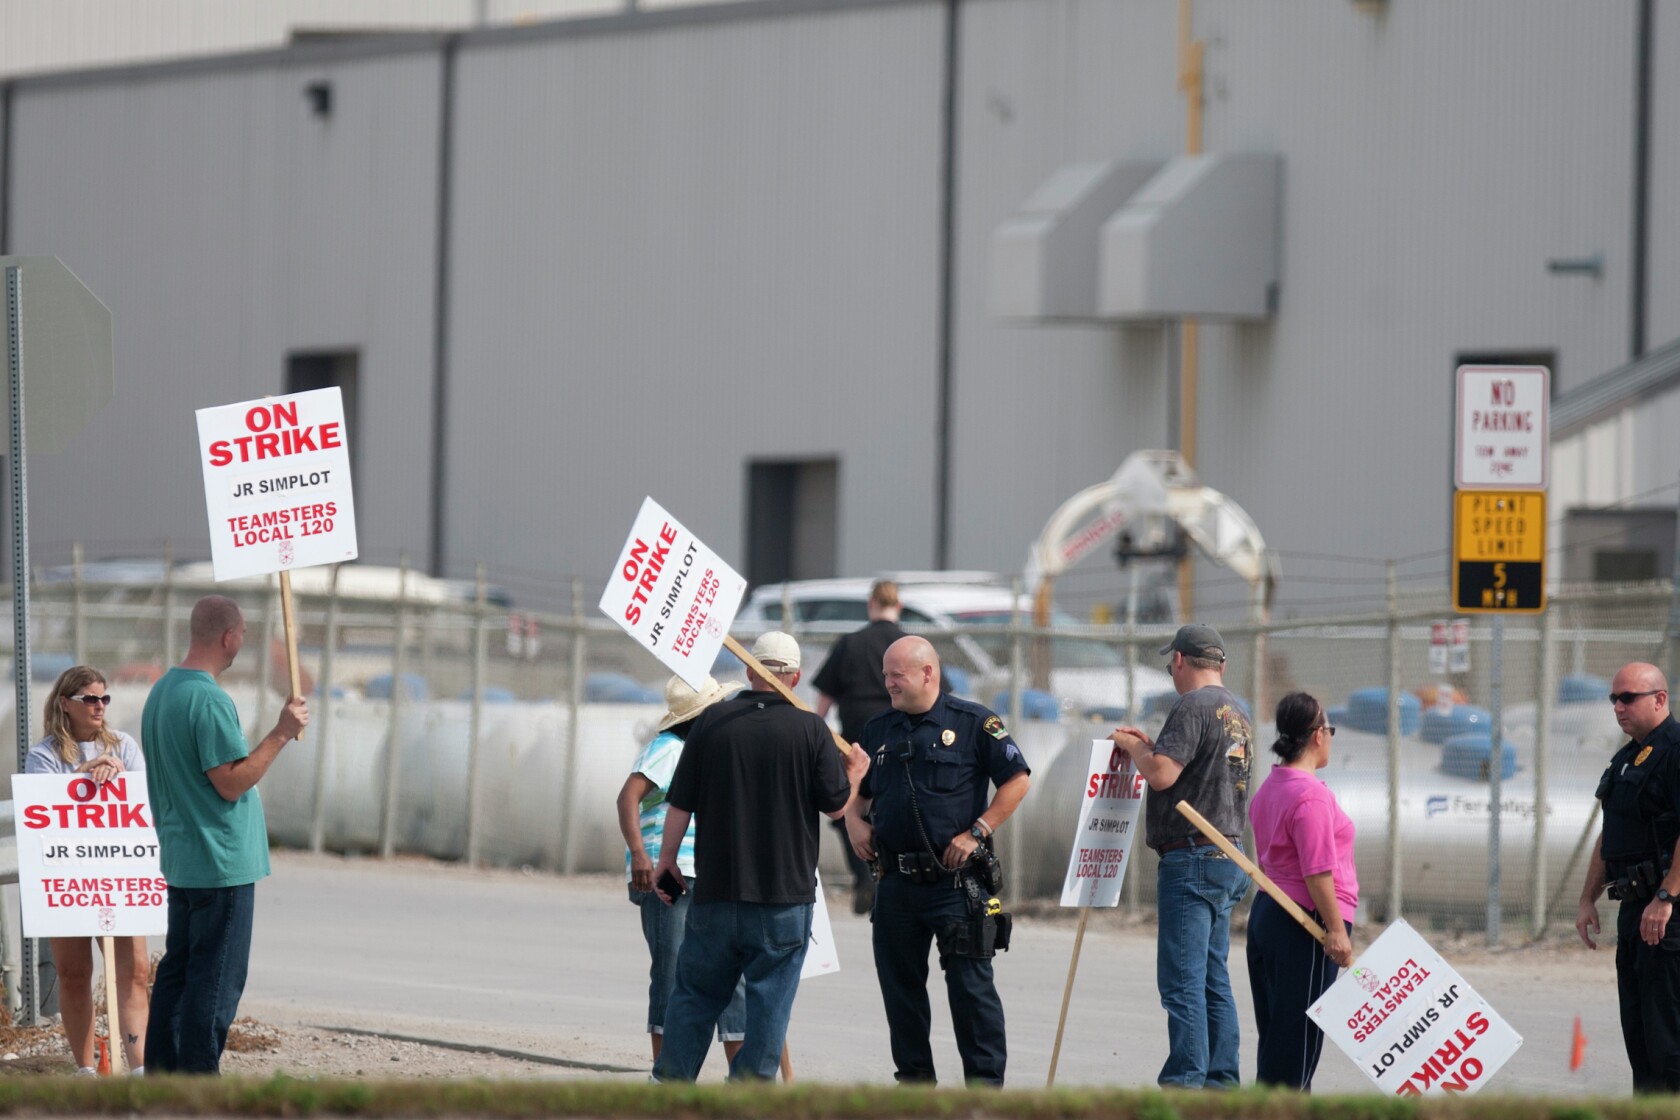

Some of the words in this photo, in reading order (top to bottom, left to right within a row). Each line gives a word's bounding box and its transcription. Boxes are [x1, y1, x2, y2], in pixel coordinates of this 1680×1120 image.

[1491, 380, 1515, 407] NO
[245, 401, 298, 432] ON
[1472, 410, 1533, 433] PARKING
[209, 422, 341, 466] STRIKE
[233, 482, 254, 498] JR
[258, 470, 331, 494] SIMPLOT
[227, 501, 337, 532] TEAMSTERS
[1472, 517, 1526, 535] SPEED
[234, 526, 294, 547] LOCAL
[300, 518, 334, 537] 120
[622, 537, 649, 582] ON
[1477, 538, 1523, 556] LIMIT
[625, 521, 678, 626] STRIKE
[1493, 563, 1507, 588] 5
[648, 621, 665, 646] JR
[660, 541, 698, 619] SIMPLOT
[671, 567, 714, 652] TEAMSTERS
[681, 610, 708, 658] LOCAL
[705, 578, 720, 607] 120
[1109, 747, 1131, 772] ON
[67, 777, 127, 803] ON
[1087, 773, 1144, 799] STRIKE
[23, 803, 156, 829] STRIK
[1089, 818, 1098, 831] JR
[1099, 818, 1129, 833] SIMPLOT
[45, 845, 70, 858] JR
[76, 845, 158, 858] SIMPLOT
[1079, 848, 1123, 863] TEAMSTERS
[1076, 863, 1102, 878] LOCAL
[1103, 864, 1118, 878] 120
[41, 877, 168, 892] TEAMSTERS
[47, 893, 116, 907] LOCAL
[124, 893, 163, 907] 120
[1372, 958, 1418, 1001] LOCAL
[1353, 967, 1431, 1043] TEAMSTERS
[1438, 984, 1459, 1009] JR
[1347, 1001, 1374, 1030] 120
[1371, 1007, 1440, 1078] SIMPLOT
[1395, 1011, 1490, 1098] STRIKE
[1440, 1057, 1484, 1098] ON
